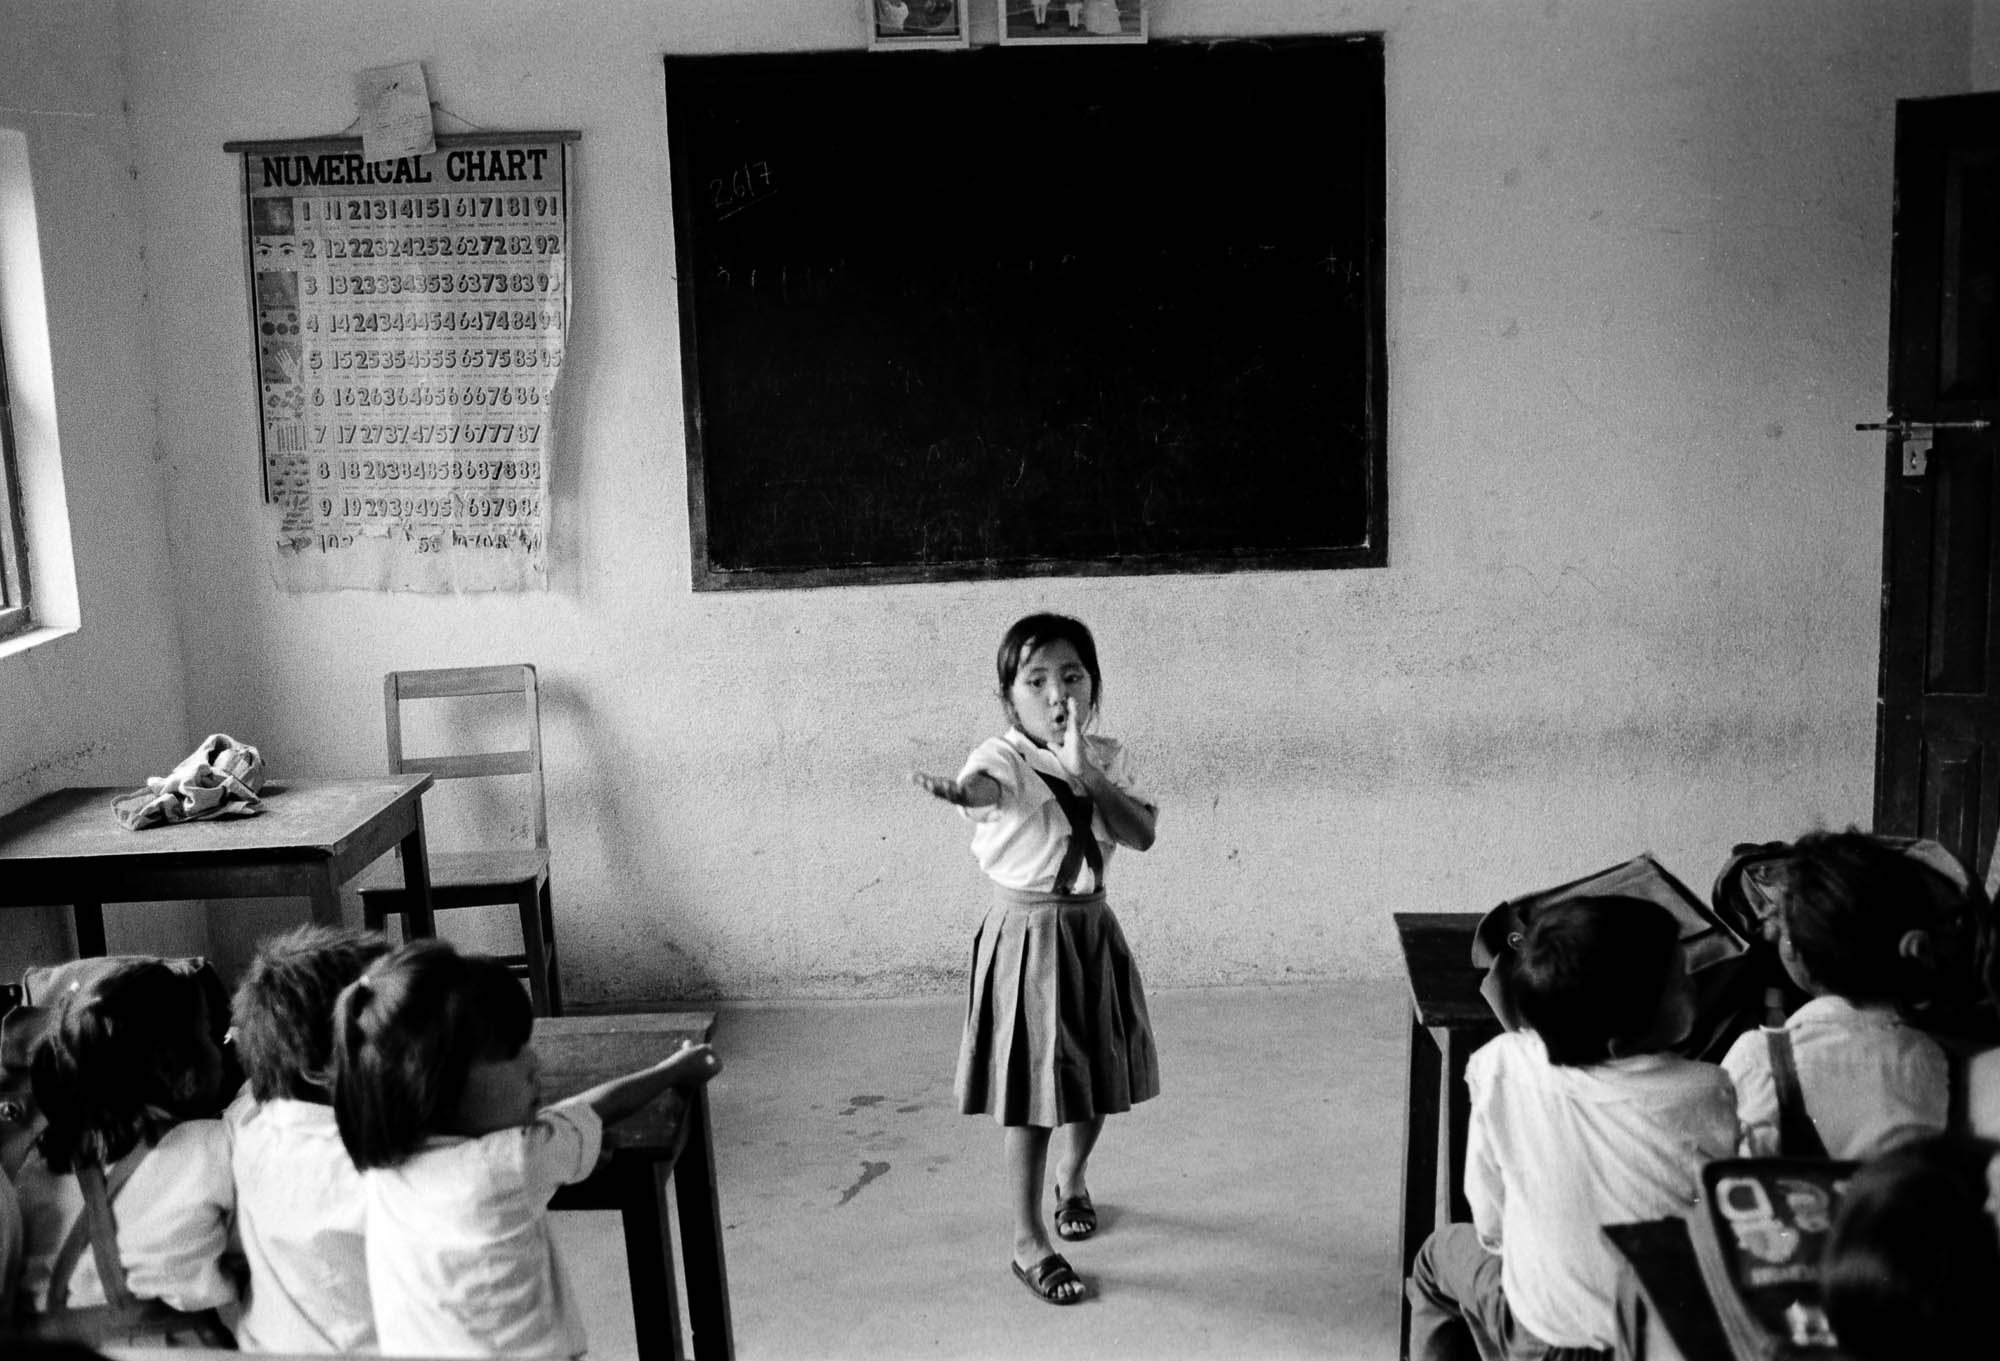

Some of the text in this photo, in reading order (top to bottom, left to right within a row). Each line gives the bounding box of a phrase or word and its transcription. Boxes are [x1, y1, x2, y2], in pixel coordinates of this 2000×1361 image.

[262, 148, 548, 187] NUMERICAL CHART
[303, 196, 557, 220] 1 11 21 31 41 51 61 71 81 91
[302, 234, 560, 258] 2 12 22 32 42 52 62 72 82 92
[304, 275, 318, 295] 3
[327, 275, 348, 295] 13
[349, 275, 376, 295] 23
[376, 275, 402, 294] 33
[402, 274, 428, 293] 43
[427, 274, 454, 293] 53
[455, 274, 481, 293] 63
[482, 273, 508, 292] 73
[510, 273, 534, 292] 83
[306, 314, 319, 333] 4
[329, 313, 350, 333] 14
[353, 313, 378, 332] 24
[379, 313, 404, 332] 34
[429, 311, 455, 331] 54
[458, 311, 483, 331] 64
[483, 311, 509, 330] 74
[511, 311, 536, 330] 84
[311, 351, 323, 370] 5
[332, 351, 353, 370] 15
[355, 351, 380, 369] 25
[382, 351, 406, 369] 35
[406, 350, 431, 368] 45
[431, 350, 456, 369] 55
[460, 349, 484, 368] 65
[486, 349, 512, 368] 75
[513, 349, 537, 368] 85
[312, 388, 325, 407] 6
[334, 388, 356, 407] 16
[358, 388, 382, 406] 26
[383, 388, 408, 406] 36
[408, 387, 433, 406] 46
[433, 387, 459, 406] 56
[462, 387, 486, 406] 66
[488, 386, 512, 406] 76
[516, 387, 540, 405] 86
[314, 424, 540, 444] 7 17 27 37 47 57 67 77 87
[318, 461, 331, 480] 8
[339, 461, 361, 480] 18
[362, 461, 387, 480] 28
[386, 461, 412, 480] 38
[412, 461, 437, 480] 48
[438, 461, 463, 480] 58
[464, 460, 490, 480] 68
[490, 460, 517, 480] 78
[320, 498, 332, 517] 9
[342, 498, 361, 517] 19
[364, 498, 388, 517] 29
[389, 498, 413, 517] 39
[414, 498, 438, 517] 49
[468, 498, 490, 517] 69
[491, 498, 517, 517] 79
